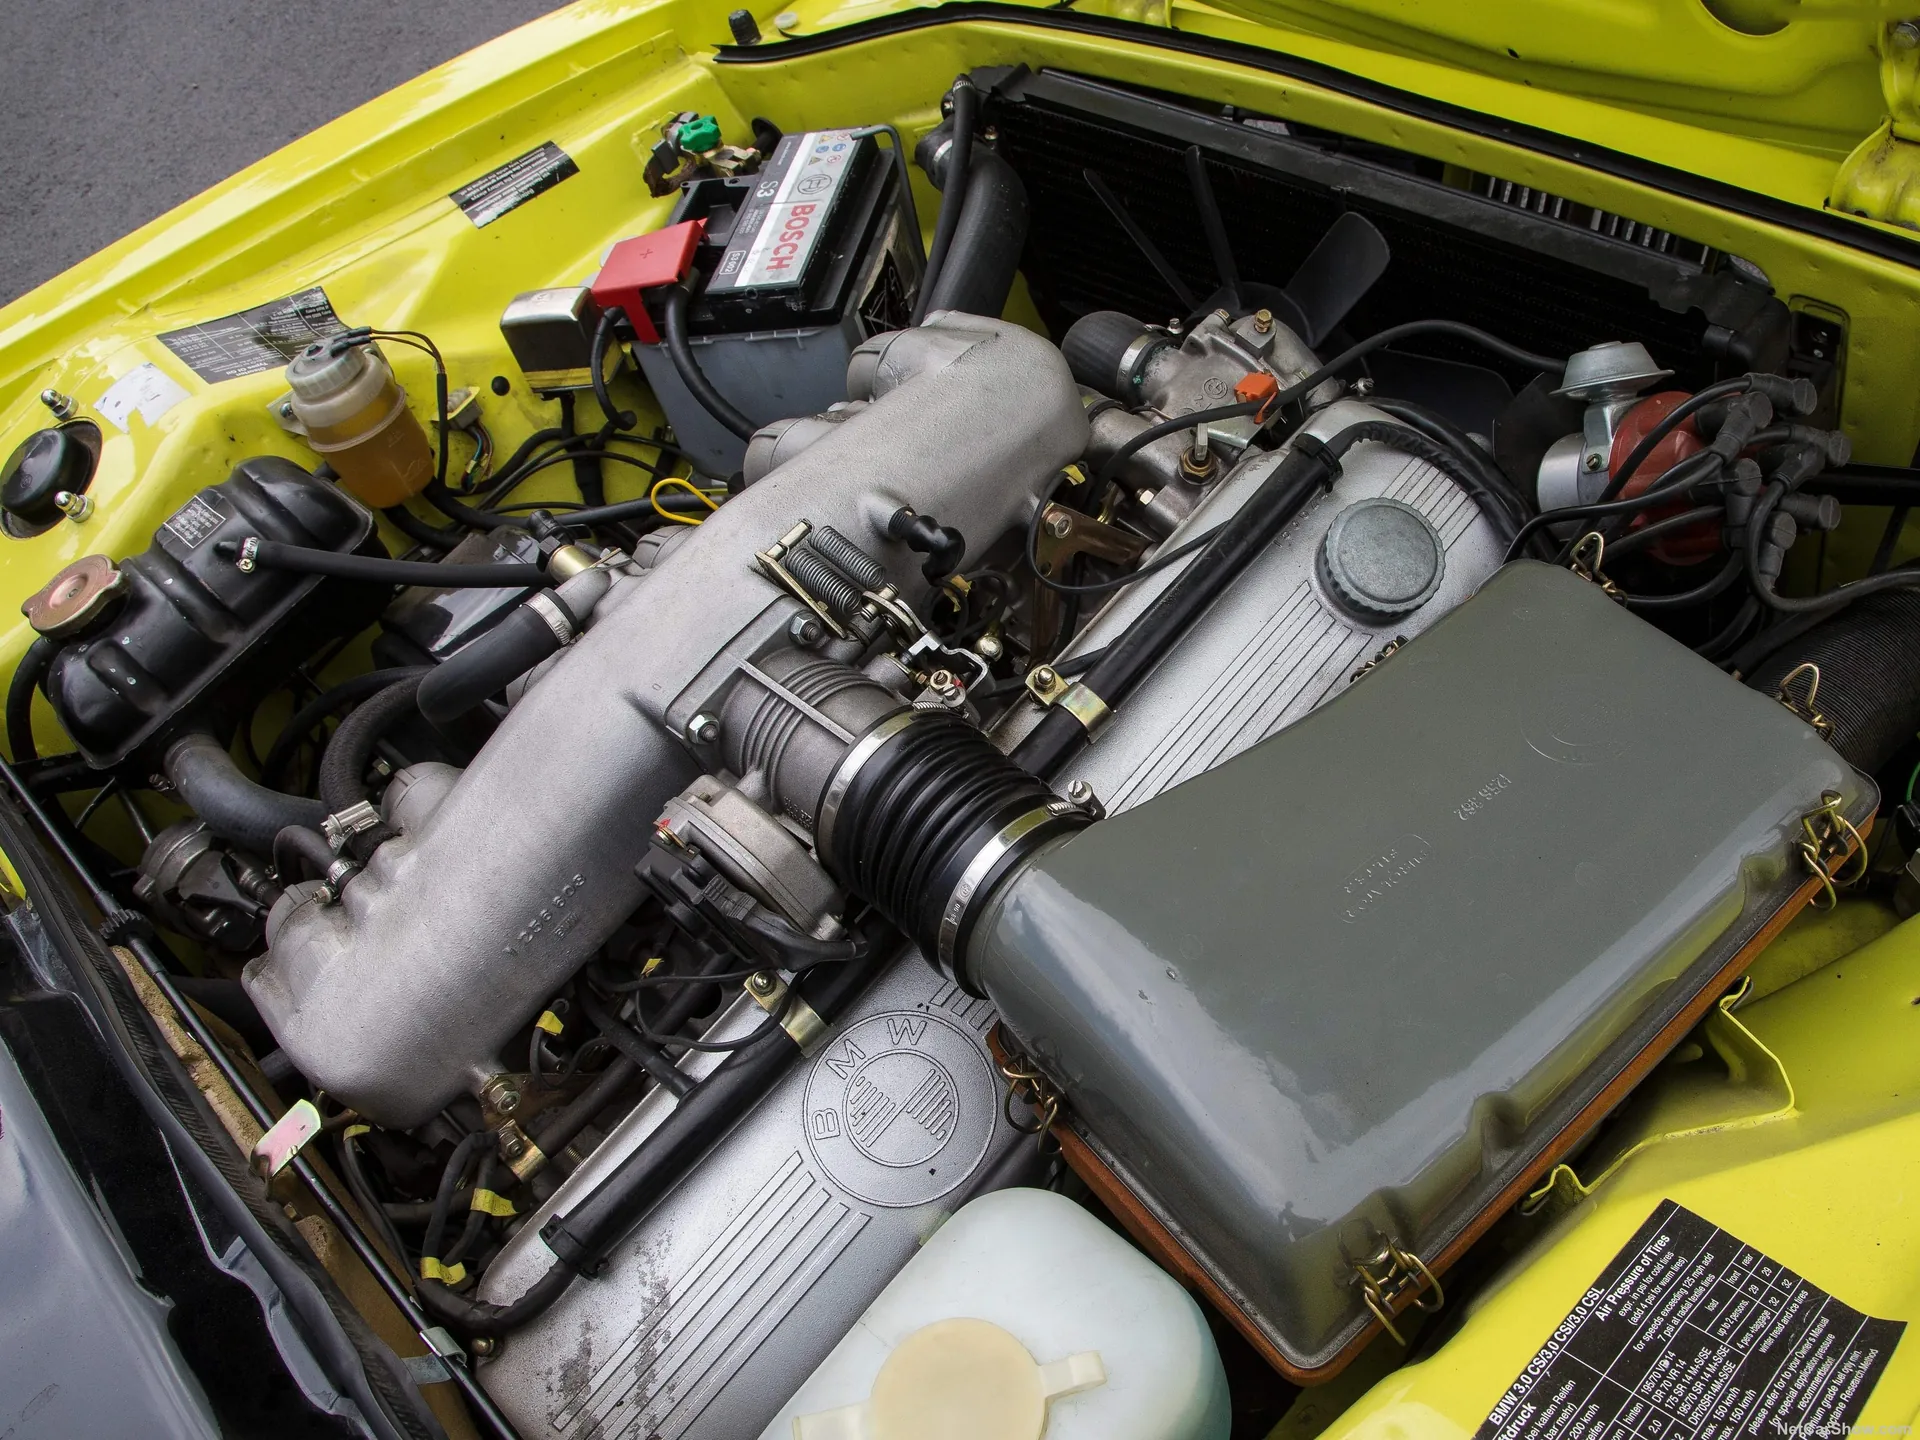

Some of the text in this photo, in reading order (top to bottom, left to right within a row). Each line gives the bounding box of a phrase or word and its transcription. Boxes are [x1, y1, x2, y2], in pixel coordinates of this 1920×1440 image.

[757, 180, 778, 198] S3
[732, 252, 741, 260] S3
[766, 203, 817, 271] BOSCH
[811, 1018, 928, 1141] BMW
[1595, 1235, 1670, 1321] Air Pressure of Tires
[1637, 1282, 1647, 1294] psi
[1642, 1275, 1654, 1284] for
[1651, 1262, 1664, 1276] cold
[1660, 1252, 1674, 1264] tires
[1726, 1270, 1741, 1284] front
[1742, 1254, 1753, 1266] rear
[1762, 1267, 1772, 1276] 29
[1628, 1308, 1644, 1325] (add
[1645, 1293, 1656, 1305] psi
[1651, 1285, 1662, 1294] for
[1659, 1271, 1675, 1286] warm
[1671, 1256, 1688, 1271] tires)
[1633, 1252, 1714, 1352] for speeds exceeding 125 mph add
[1749, 1285, 1759, 1294] 29
[1769, 1297, 1779, 1306] 32
[1782, 1279, 1792, 1288] 32
[1664, 1323, 1675, 1337] psi
[1672, 1316, 1680, 1325] at
[1677, 1300, 1693, 1318] radial
[1688, 1286, 1705, 1302] textile
[1701, 1274, 1715, 1287] tires
[1705, 1299, 1719, 1311] load
[1717, 1328, 1727, 1336] up
[1730, 1300, 1749, 1321] persons.
[1759, 1290, 1808, 1353] winter tread and ice tires
[1489, 1391, 1518, 1425] BMW
[1513, 1375, 1532, 1394] 3,0
[1528, 1341, 1559, 1376] CS/3,0
[1582, 1288, 1604, 1306] CSL
[1741, 1333, 1753, 1346] pers
[1641, 1371, 1661, 1394] 195/70
[1665, 1351, 1676, 1360] 14
[1652, 1359, 1686, 1403] DR 70 VR 14
[1665, 1347, 1711, 1409] 175 SR 14 M+S/SE
[1677, 1393, 1697, 1416] 195/70
[1692, 1381, 1705, 1394] SR
[1701, 1372, 1711, 1381] 14
[1706, 1345, 1729, 1373] M+S/SE
[1748, 1408, 1768, 1435] please
[1765, 1389, 1779, 1408] refer
[1774, 1378, 1786, 1390] for
[1781, 1371, 1791, 1379] to
[1788, 1357, 1800, 1373] your
[1809, 1316, 1829, 1338] Manual
[1769, 1334, 1835, 1427] for special application pressure
[1822, 1385, 1838, 1408] grade
[1832, 1372, 1846, 1385] fuel
[1840, 1370, 1865, 1402] Research
[1858, 1349, 1878, 1371] Method
[1525, 1380, 1576, 1440] bei kalten Reifen
[1544, 1403, 1577, 1440] bar mehr)
[1569, 1404, 1599, 1439] 200 km/h
[1623, 1403, 1643, 1424] hinten
[1648, 1420, 1661, 1433] 2,0
[1701, 1387, 1740, 1440] max. 150 km/h
[1729, 1408, 1744, 1423] 150
[1738, 1390, 1756, 1409] km/h
